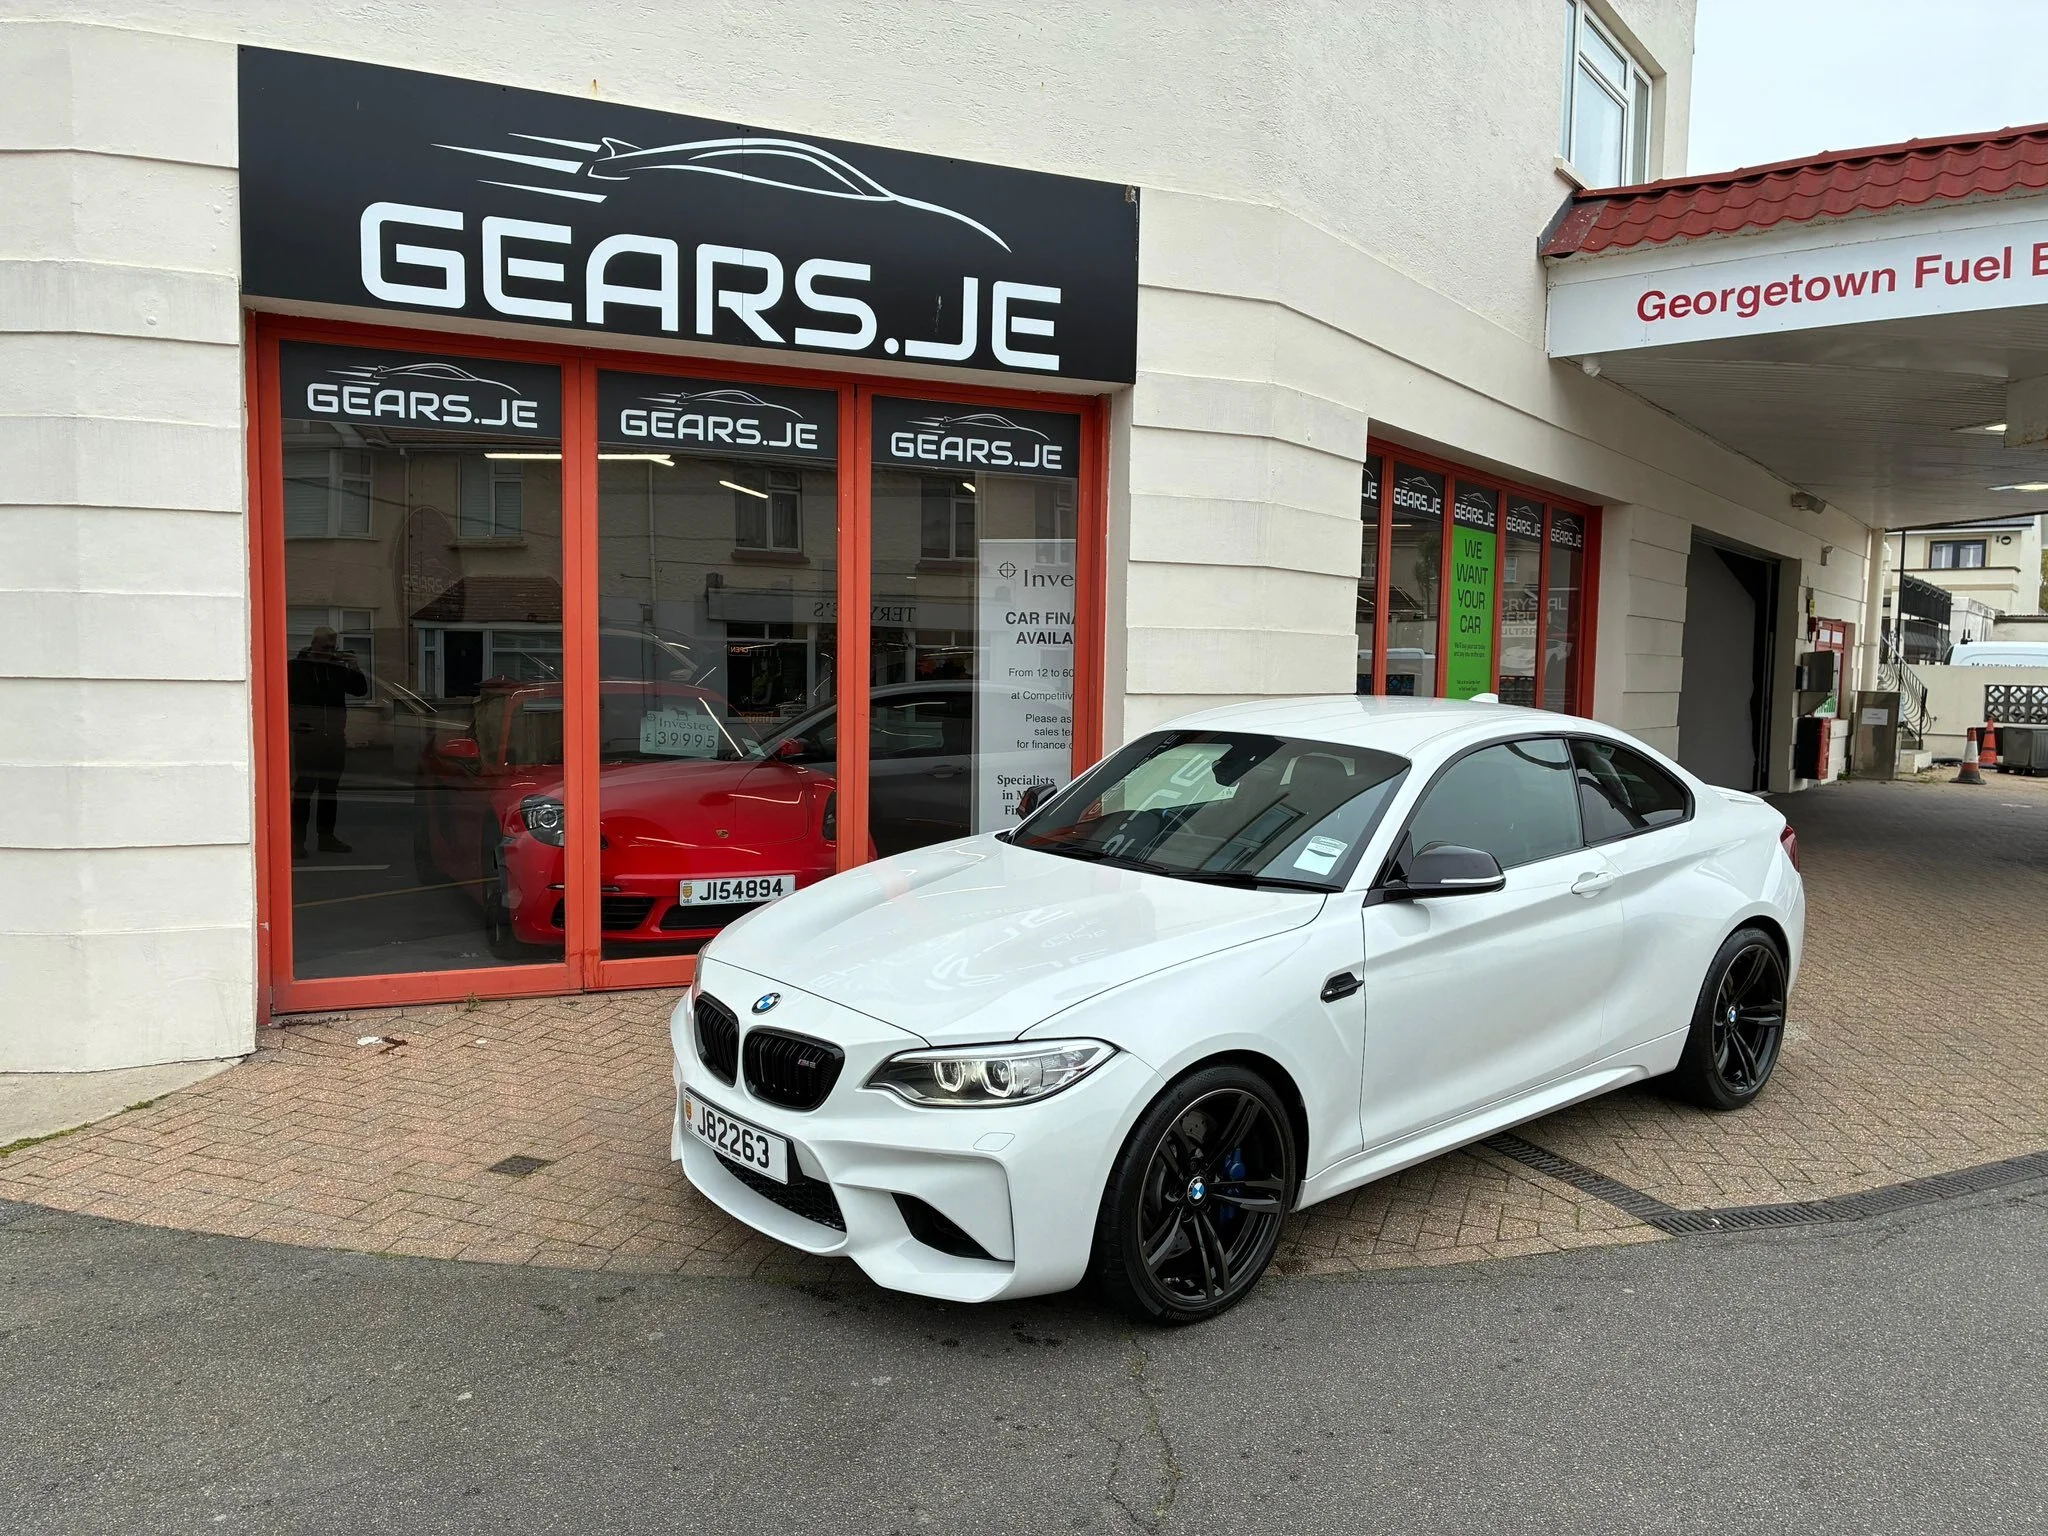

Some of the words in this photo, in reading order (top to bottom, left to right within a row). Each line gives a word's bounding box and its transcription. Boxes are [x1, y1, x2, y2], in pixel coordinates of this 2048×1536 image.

[360, 202, 1062, 371] GEARS.JE
[1637, 268, 1896, 321] Georgetown
[1914, 246, 2012, 289] Fuel
[306, 382, 538, 428] GEARS.JE
[620, 409, 818, 449] GEARS.JE
[891, 432, 1063, 470] GEARS.JE
[1394, 488, 1441, 514] GEARS.JE
[1455, 503, 1495, 527] GEARS.JE
[1506, 516, 1541, 537] GEARS.JE
[1551, 528, 1581, 547] GEARS.JE
[1464, 538, 1483, 559] WE
[1456, 562, 1489, 585] WANT
[1457, 588, 1486, 609] YOUR
[1005, 611, 1040, 625] CAR
[1460, 614, 1481, 634] CAR
[1016, 631, 1074, 645] AVAILA
[1008, 667, 1033, 677] From
[1037, 668, 1048, 677] 12
[1051, 668, 1060, 677] to
[1011, 692, 1020, 700] at
[660, 718, 714, 731] Investec
[1025, 713, 1058, 723] Please
[1034, 727, 1059, 737] sales
[1016, 740, 1029, 749] for
[1032, 740, 1066, 750] finance
[997, 774, 1055, 787] Specialists
[1002, 789, 1013, 800] in
[697, 1106, 770, 1169] J82263
